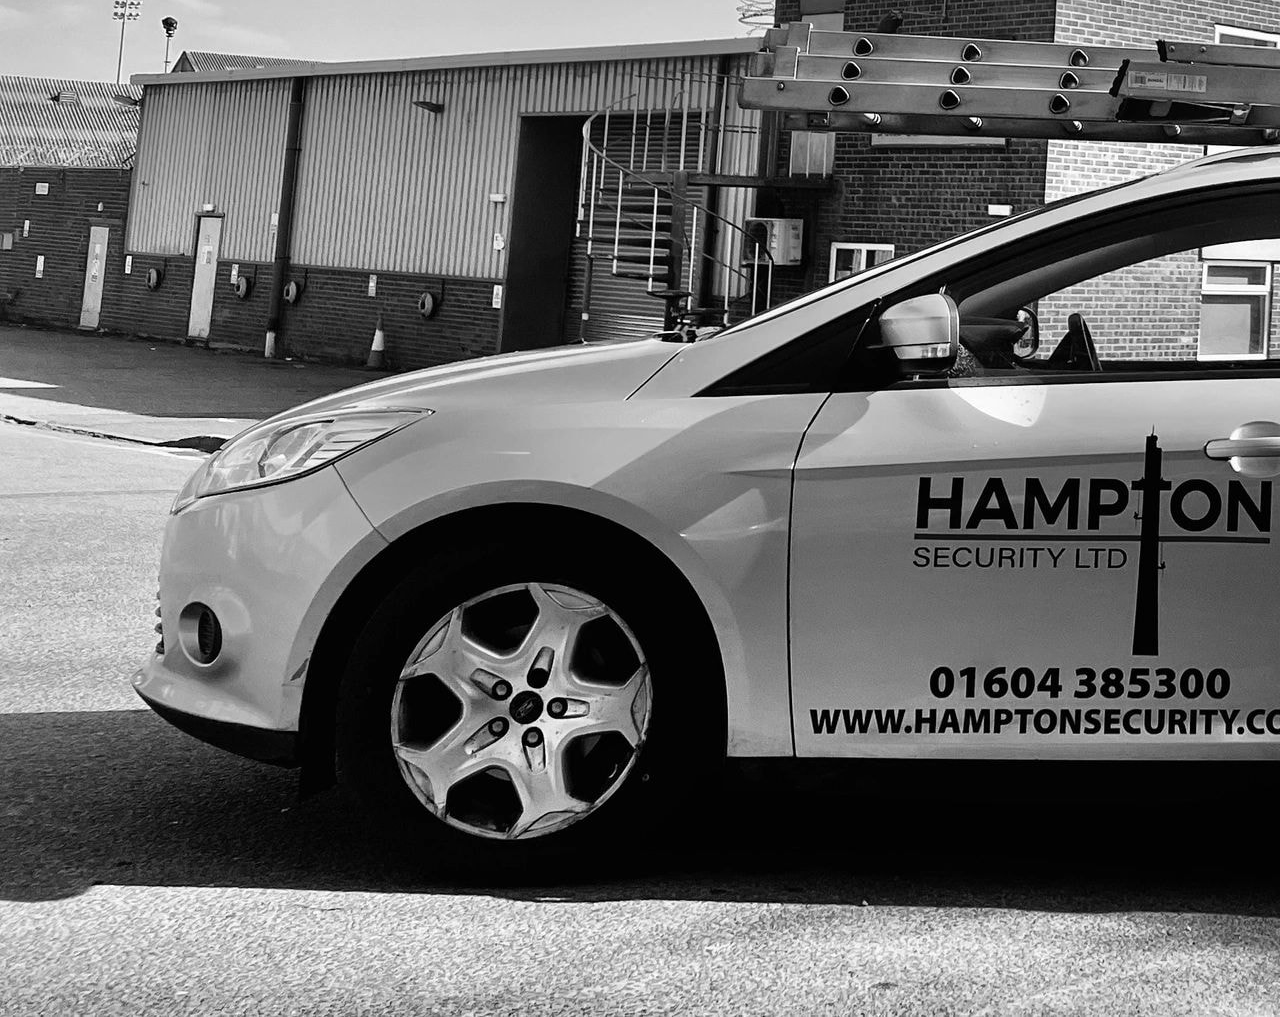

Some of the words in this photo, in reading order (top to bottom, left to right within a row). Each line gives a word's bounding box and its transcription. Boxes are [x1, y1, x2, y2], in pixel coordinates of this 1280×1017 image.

[916, 476, 1272, 532] HAMPTON
[913, 547, 1066, 569] SECURITY
[1075, 548, 1128, 569] LTD
[929, 667, 1063, 699] 01604
[1074, 668, 1231, 699] 385300
